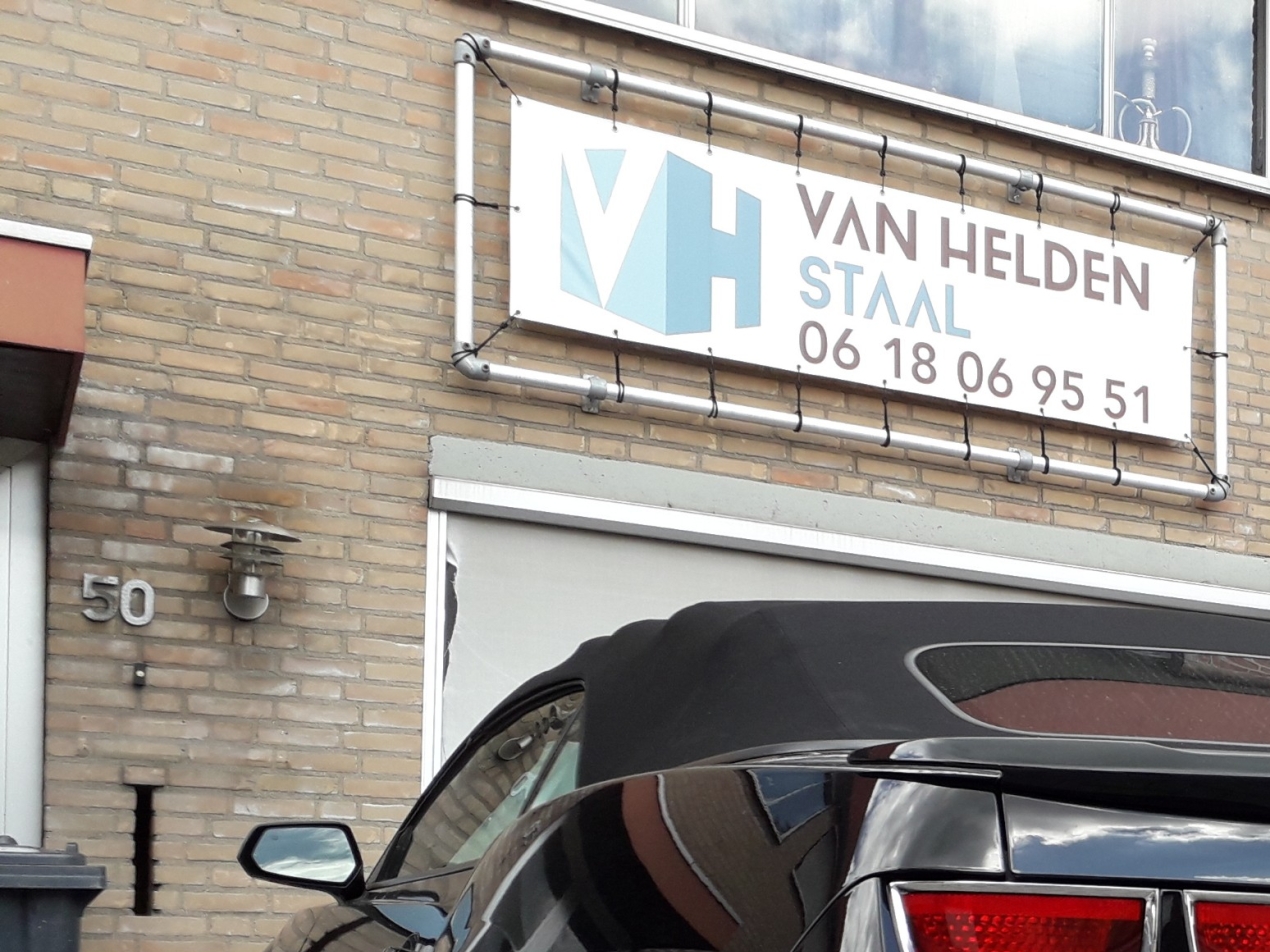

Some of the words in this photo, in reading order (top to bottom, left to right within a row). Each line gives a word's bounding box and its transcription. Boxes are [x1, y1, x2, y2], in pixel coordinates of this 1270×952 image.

[560, 149, 762, 335] VH
[796, 183, 917, 261] VAN
[941, 216, 1150, 311] HELDEN
[799, 255, 971, 339] STAAL
[799, 320, 860, 370] 06
[883, 337, 937, 384] 18
[957, 351, 1013, 398] 06
[1032, 364, 1085, 411] 95
[1104, 378, 1149, 424] 51
[82, 572, 155, 626] 50
